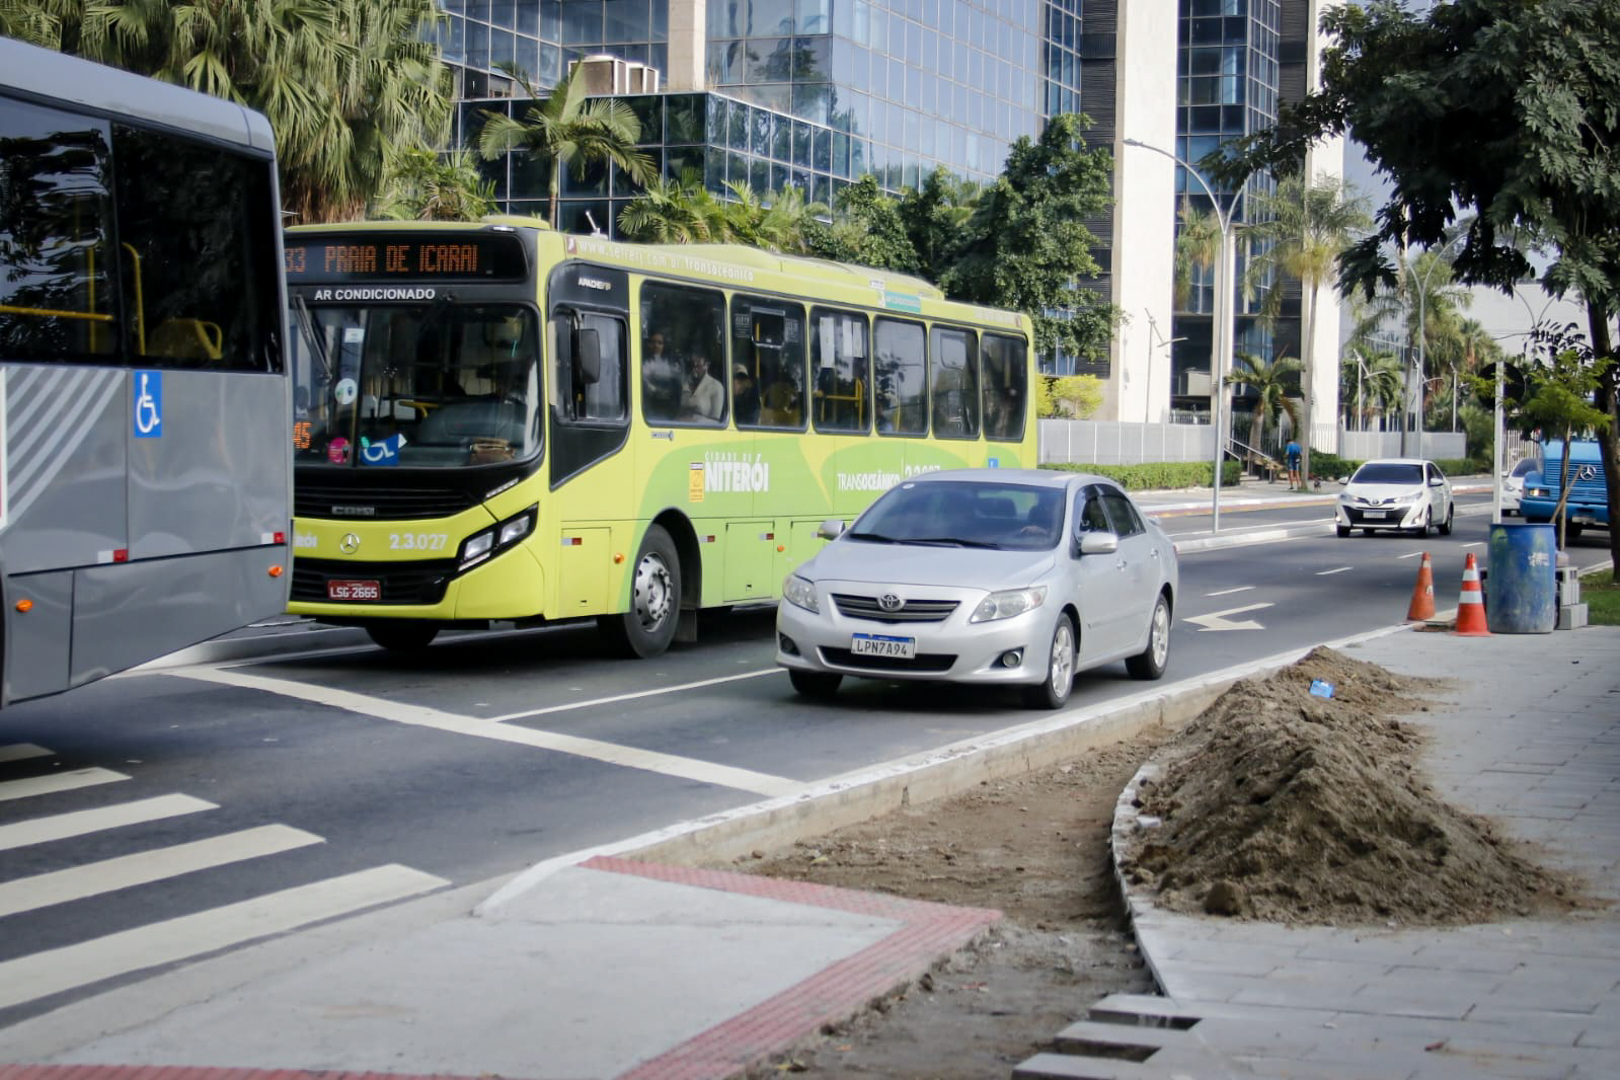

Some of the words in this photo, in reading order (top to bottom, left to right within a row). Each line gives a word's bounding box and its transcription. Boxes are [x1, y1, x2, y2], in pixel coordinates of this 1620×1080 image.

[324, 245, 376, 273] PRAIA
[386, 245, 411, 272] DE
[314, 290, 332, 301] AR
[335, 288, 436, 300] CONDICIONADO
[705, 453, 769, 492] NITERÓI
[389, 533, 449, 549] 2.3.027
[857, 639, 907, 656] LPN7A94
